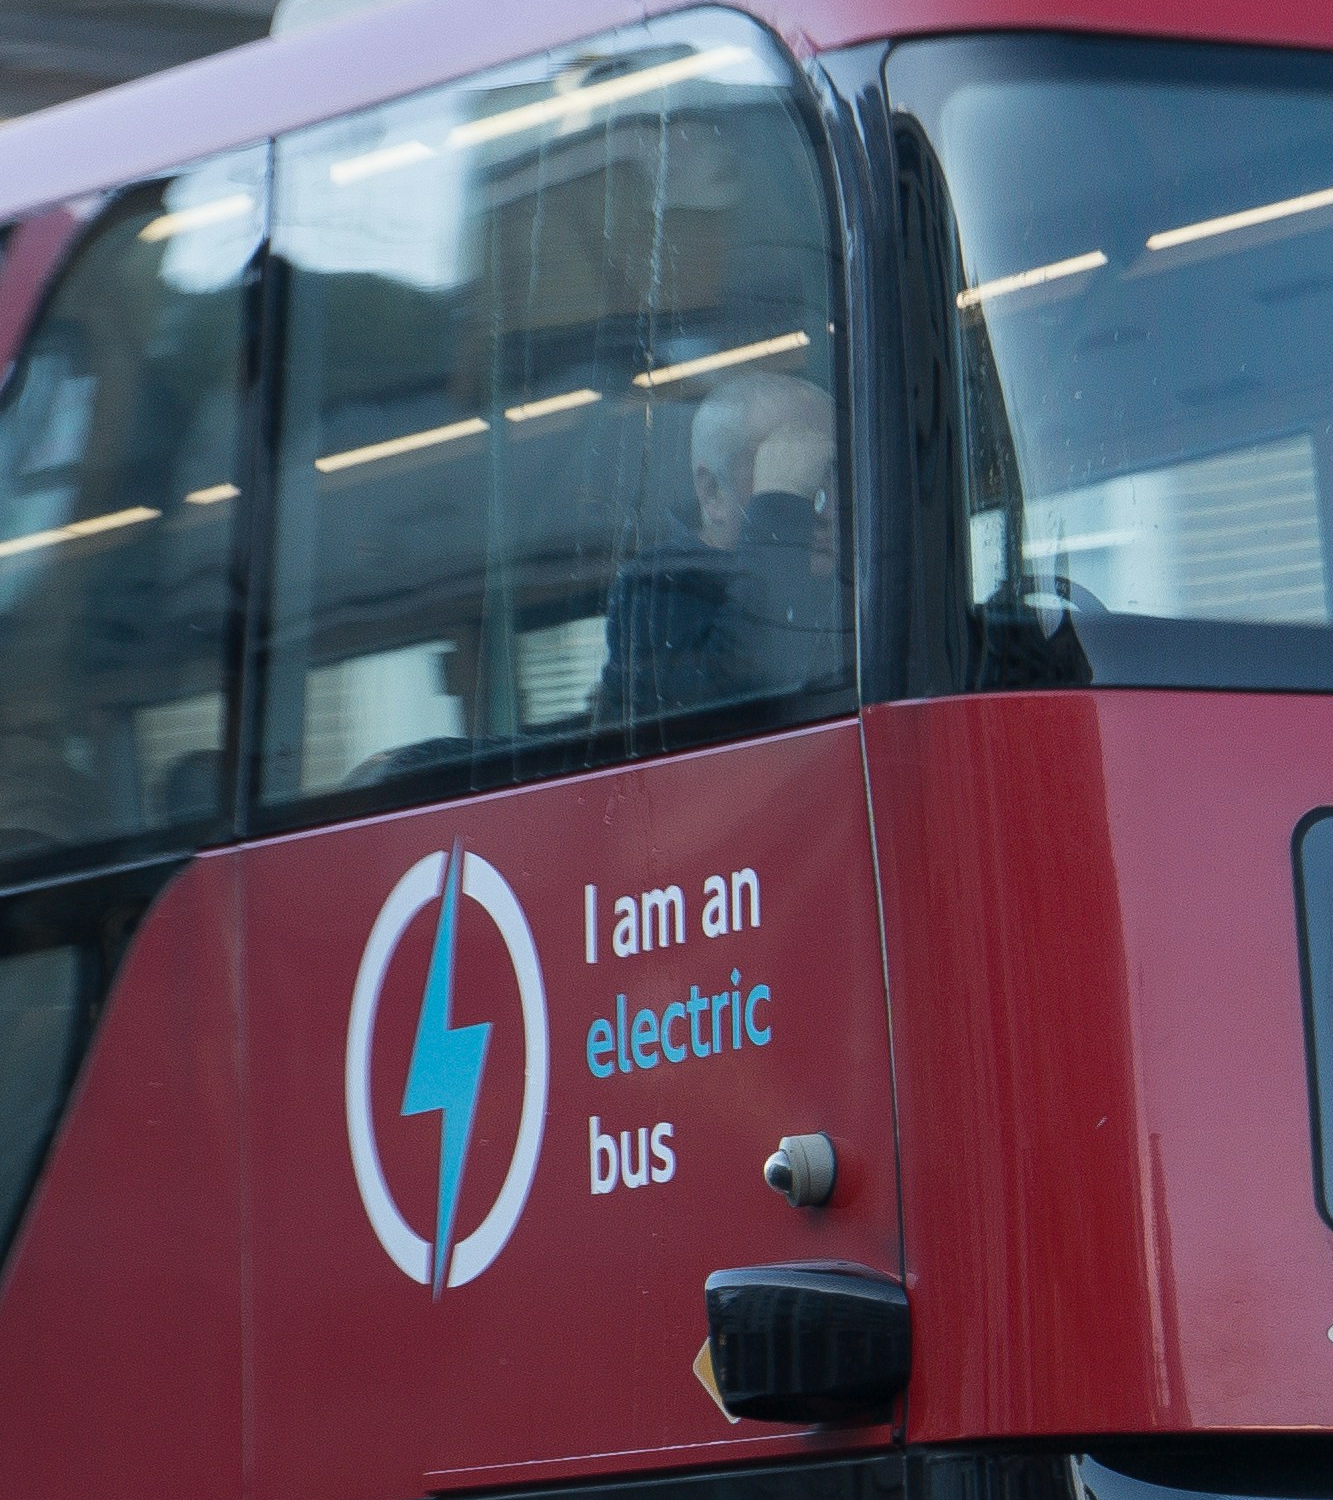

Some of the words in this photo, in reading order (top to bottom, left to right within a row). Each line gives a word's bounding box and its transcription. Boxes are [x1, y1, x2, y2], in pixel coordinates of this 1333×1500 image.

[585, 884, 598, 964] I
[612, 884, 686, 958] am
[701, 867, 761, 938] an
[586, 967, 772, 1079] electric
[588, 1115, 677, 1195] bus
